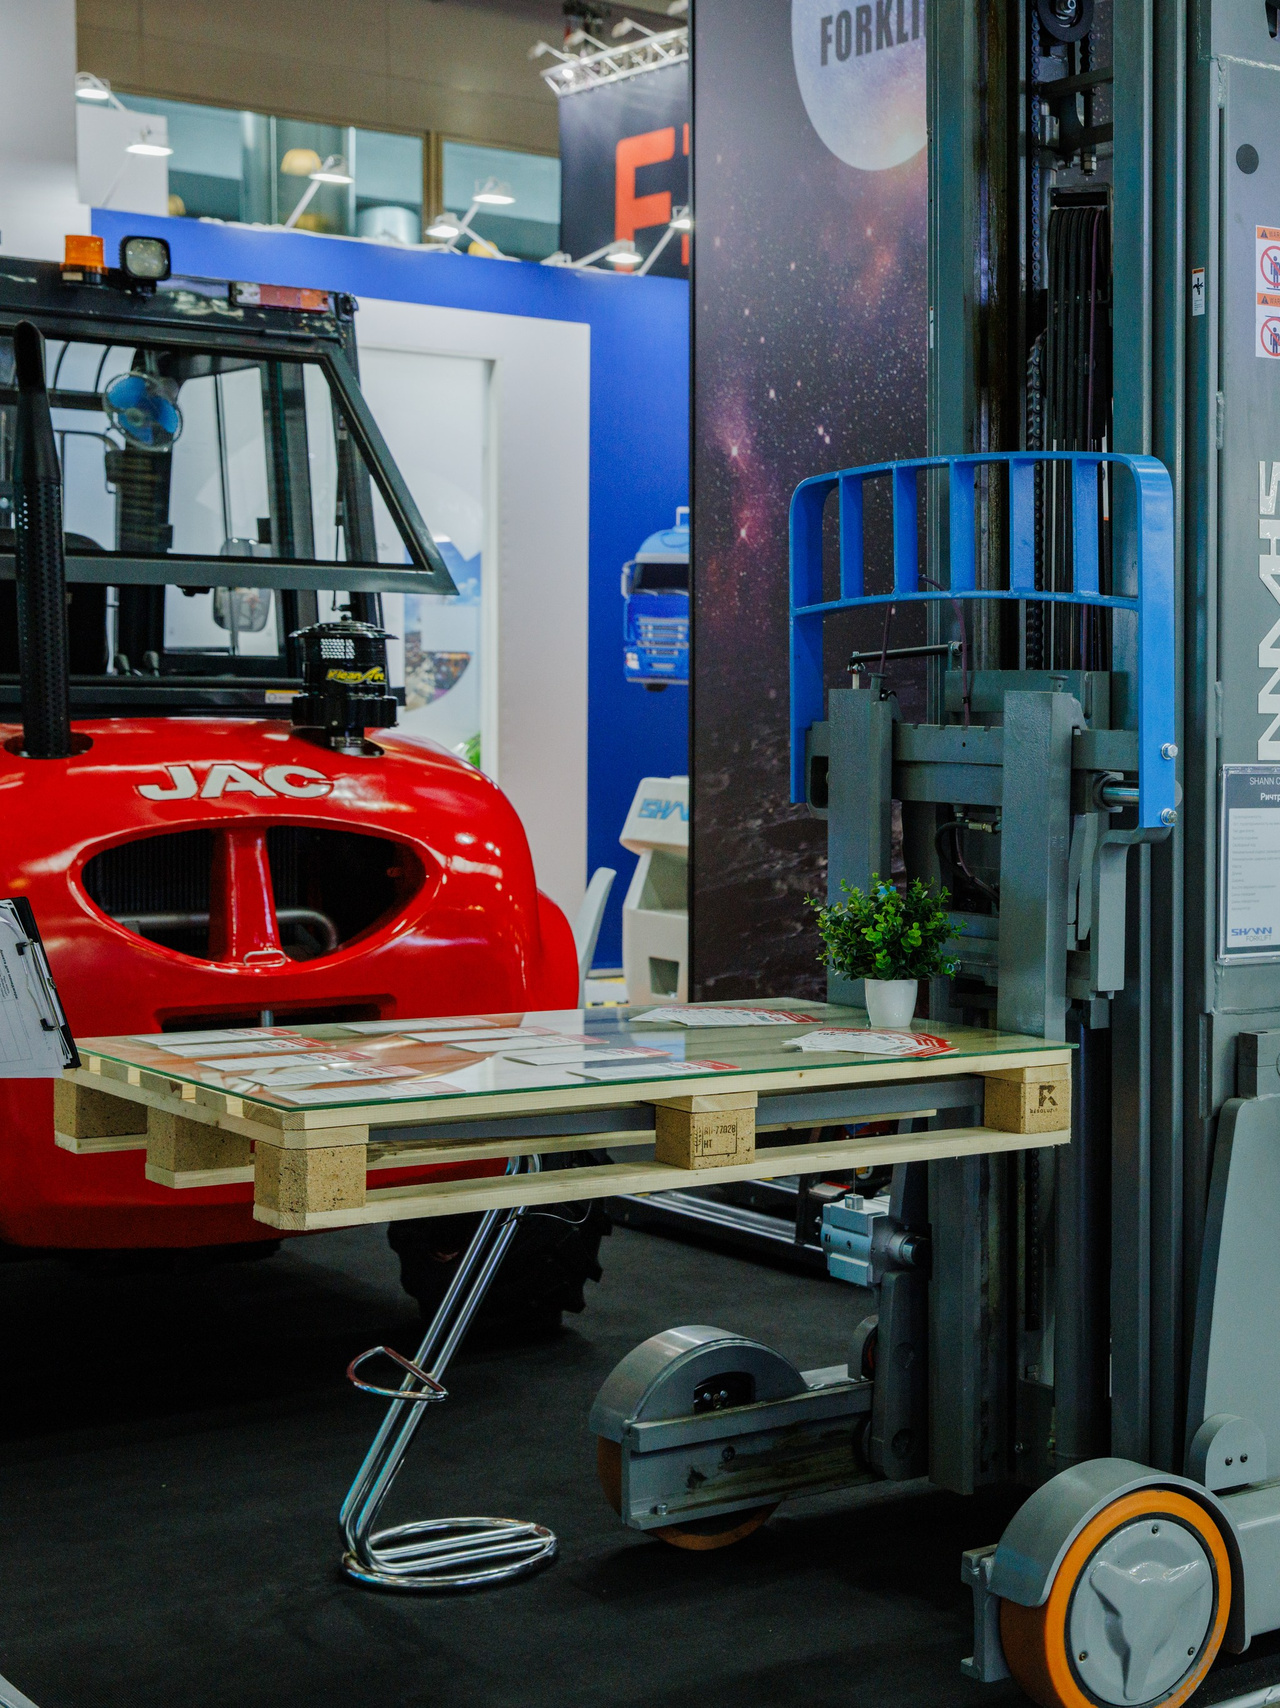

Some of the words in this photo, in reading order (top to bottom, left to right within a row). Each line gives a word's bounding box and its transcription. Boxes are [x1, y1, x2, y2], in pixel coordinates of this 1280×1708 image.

[821, 0, 926, 66] FORKLI
[137, 764, 333, 801] JAC
[1249, 777, 1275, 786] SHANN
[1231, 926, 1273, 937] SHANN
